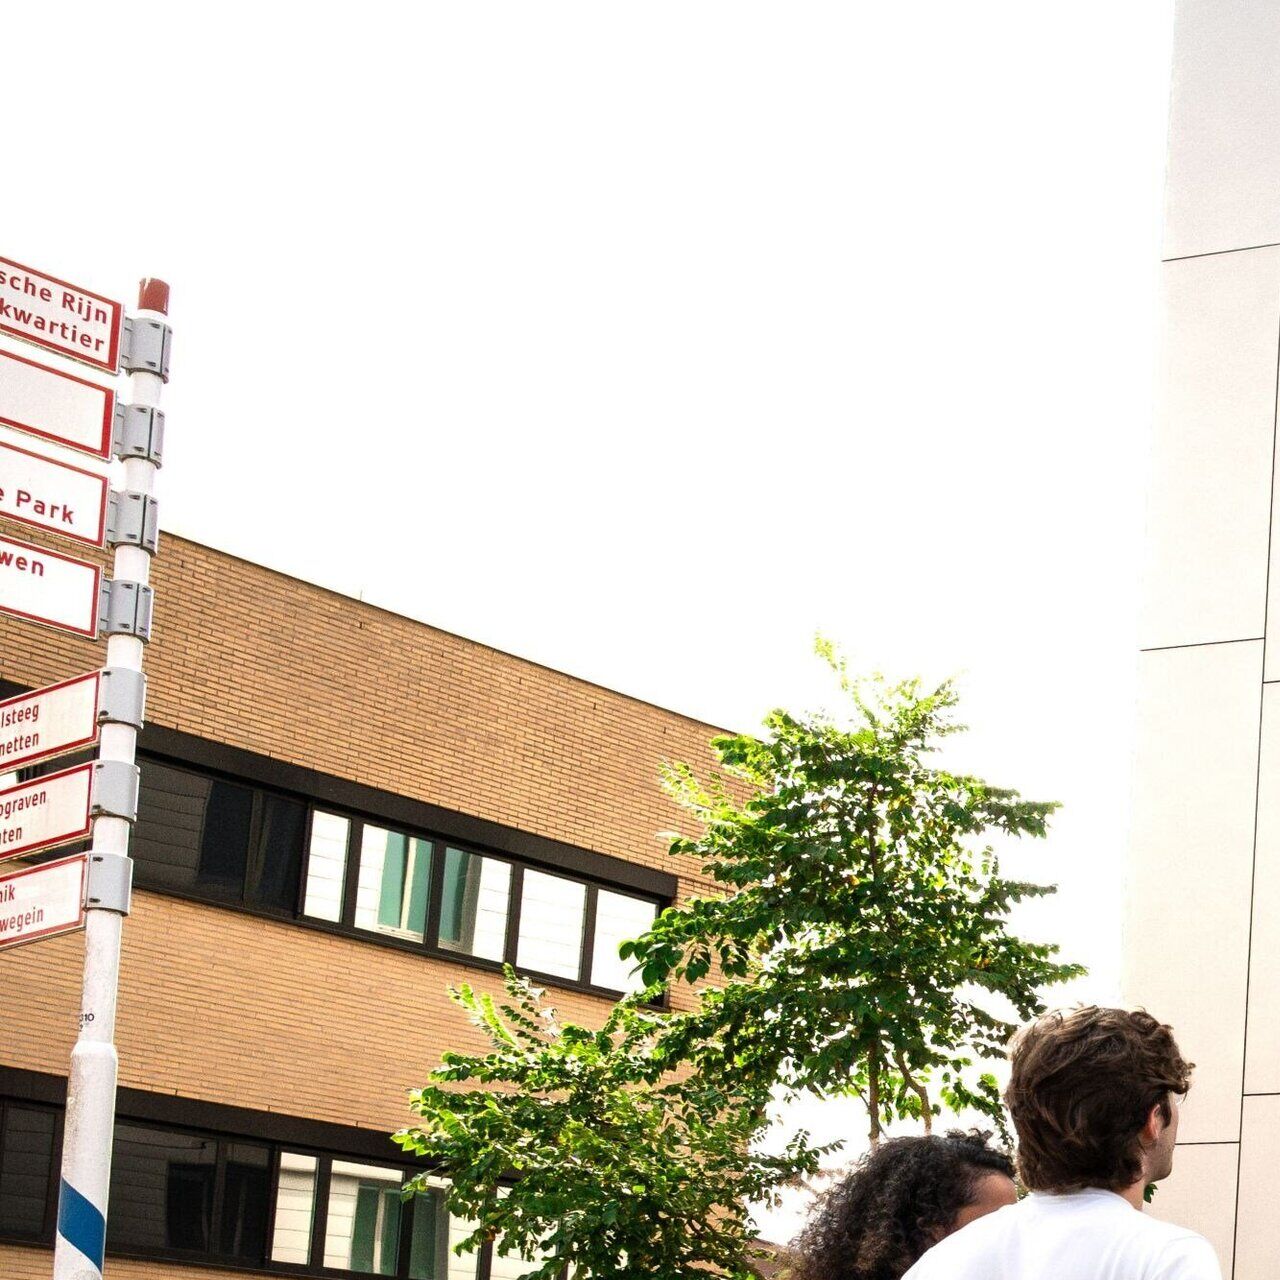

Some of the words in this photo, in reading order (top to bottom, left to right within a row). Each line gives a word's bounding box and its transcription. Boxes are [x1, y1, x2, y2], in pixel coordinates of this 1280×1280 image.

[0, 270, 52, 302] sche
[62, 291, 107, 324] Rijn
[0, 298, 104, 351] kwartier
[16, 490, 75, 525] Park
[0, 826, 22, 845] ten
